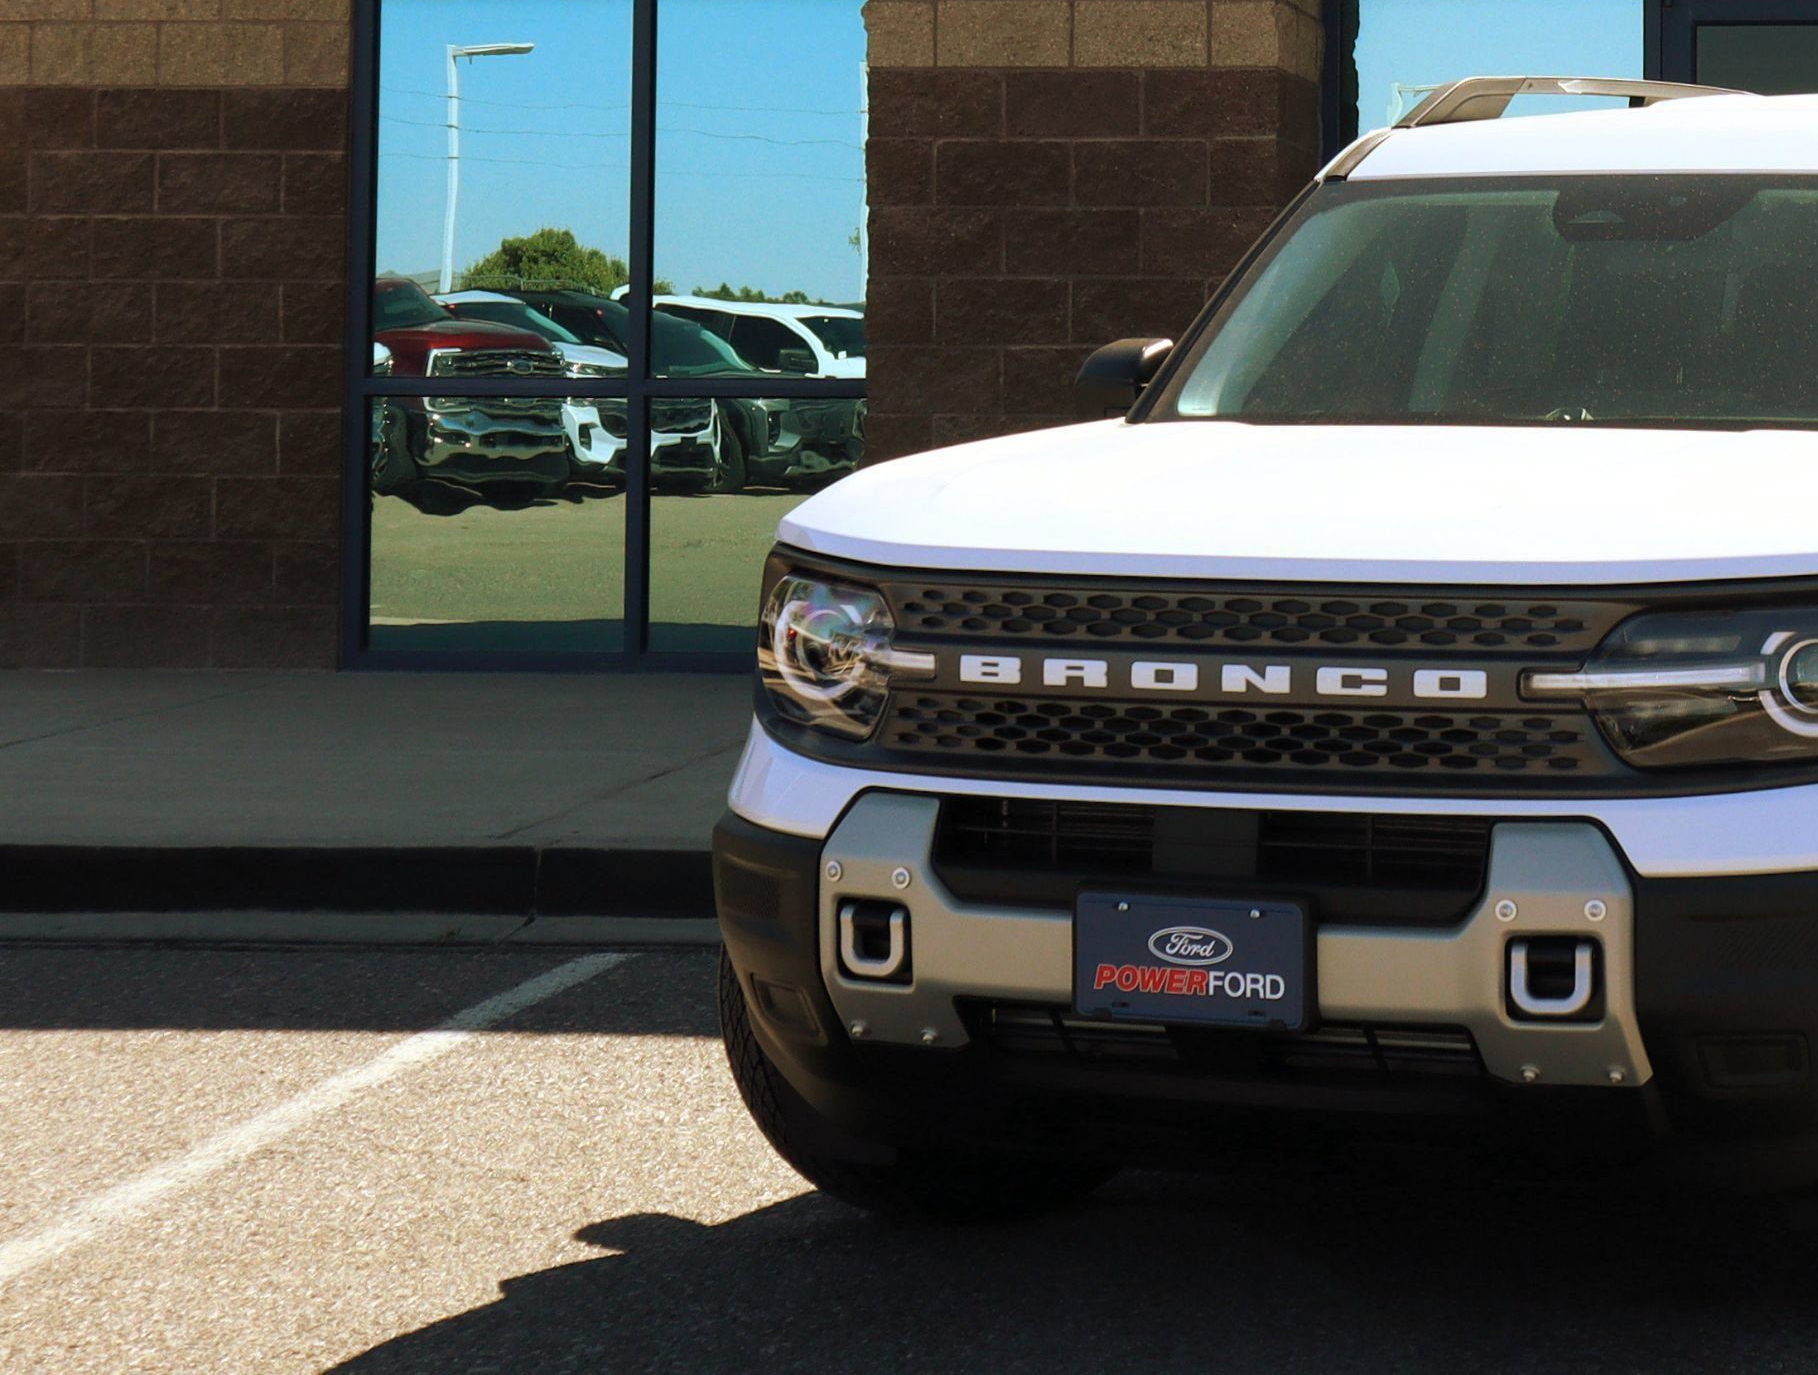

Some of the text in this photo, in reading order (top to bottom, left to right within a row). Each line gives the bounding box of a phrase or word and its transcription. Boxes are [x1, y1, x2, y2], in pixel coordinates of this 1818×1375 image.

[959, 654, 1487, 698] BRONCO
[1165, 932, 1215, 958] Ford
[1094, 963, 1286, 1000] POWERFORD
